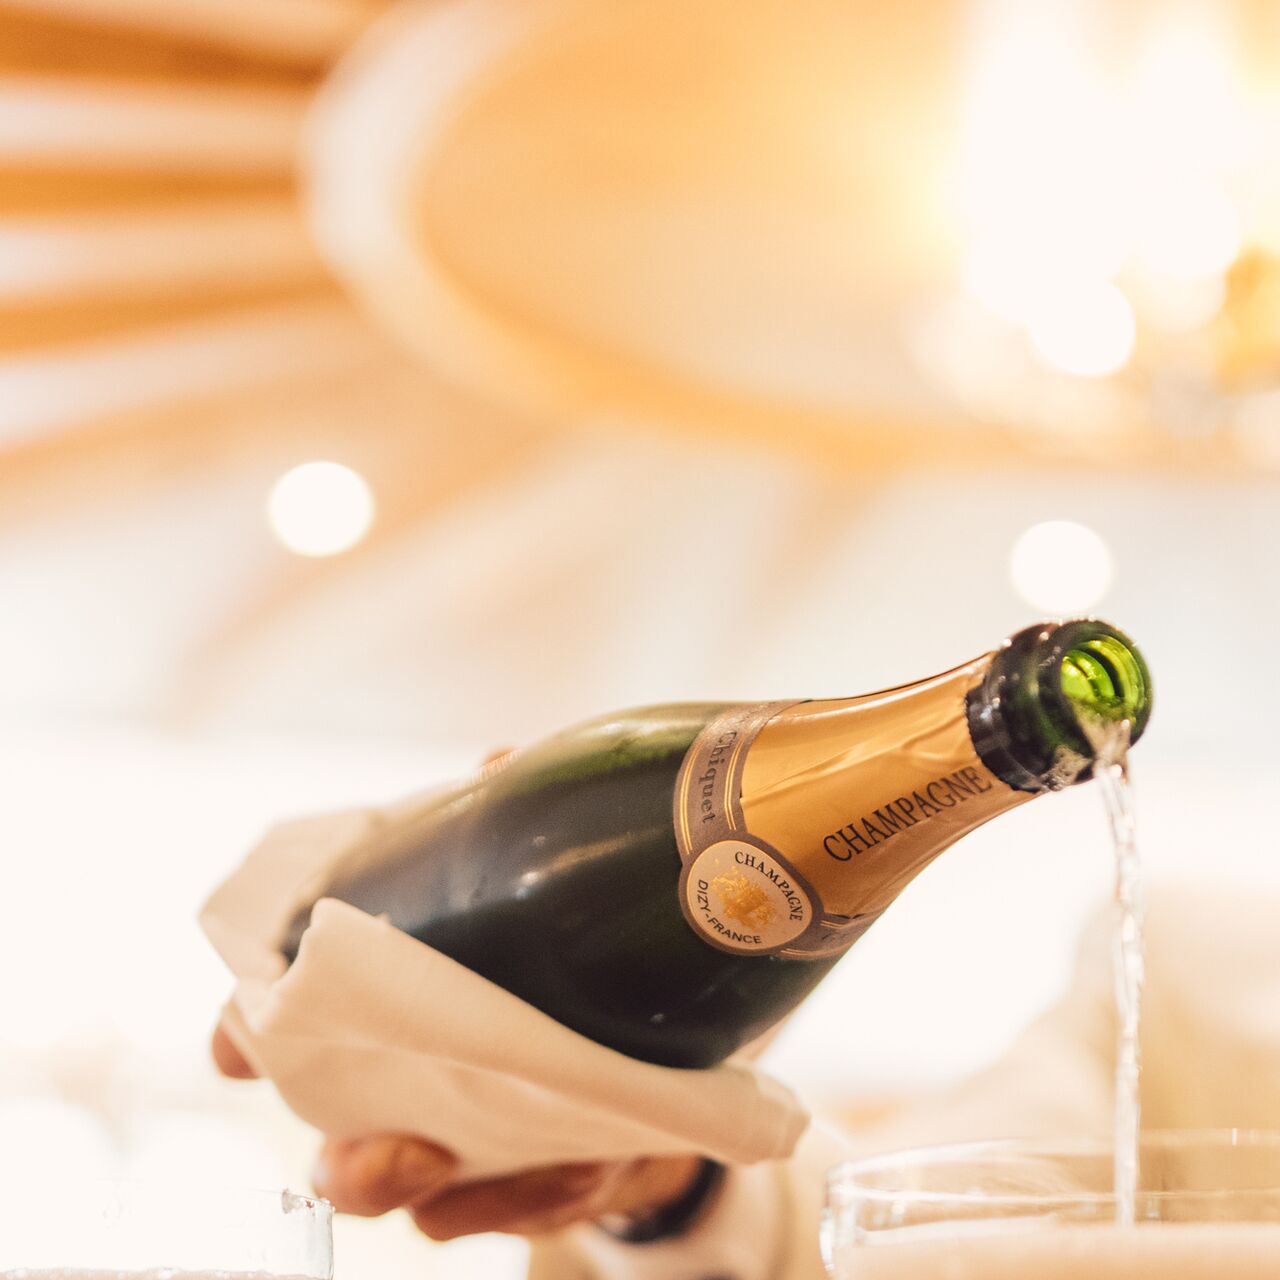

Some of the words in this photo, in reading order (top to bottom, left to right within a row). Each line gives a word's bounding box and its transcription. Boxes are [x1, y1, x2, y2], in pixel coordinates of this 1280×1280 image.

[698, 730, 738, 824] Chiquet
[823, 766, 993, 863] CHAMPAGNE
[734, 851, 804, 922] CHAMPAGNE
